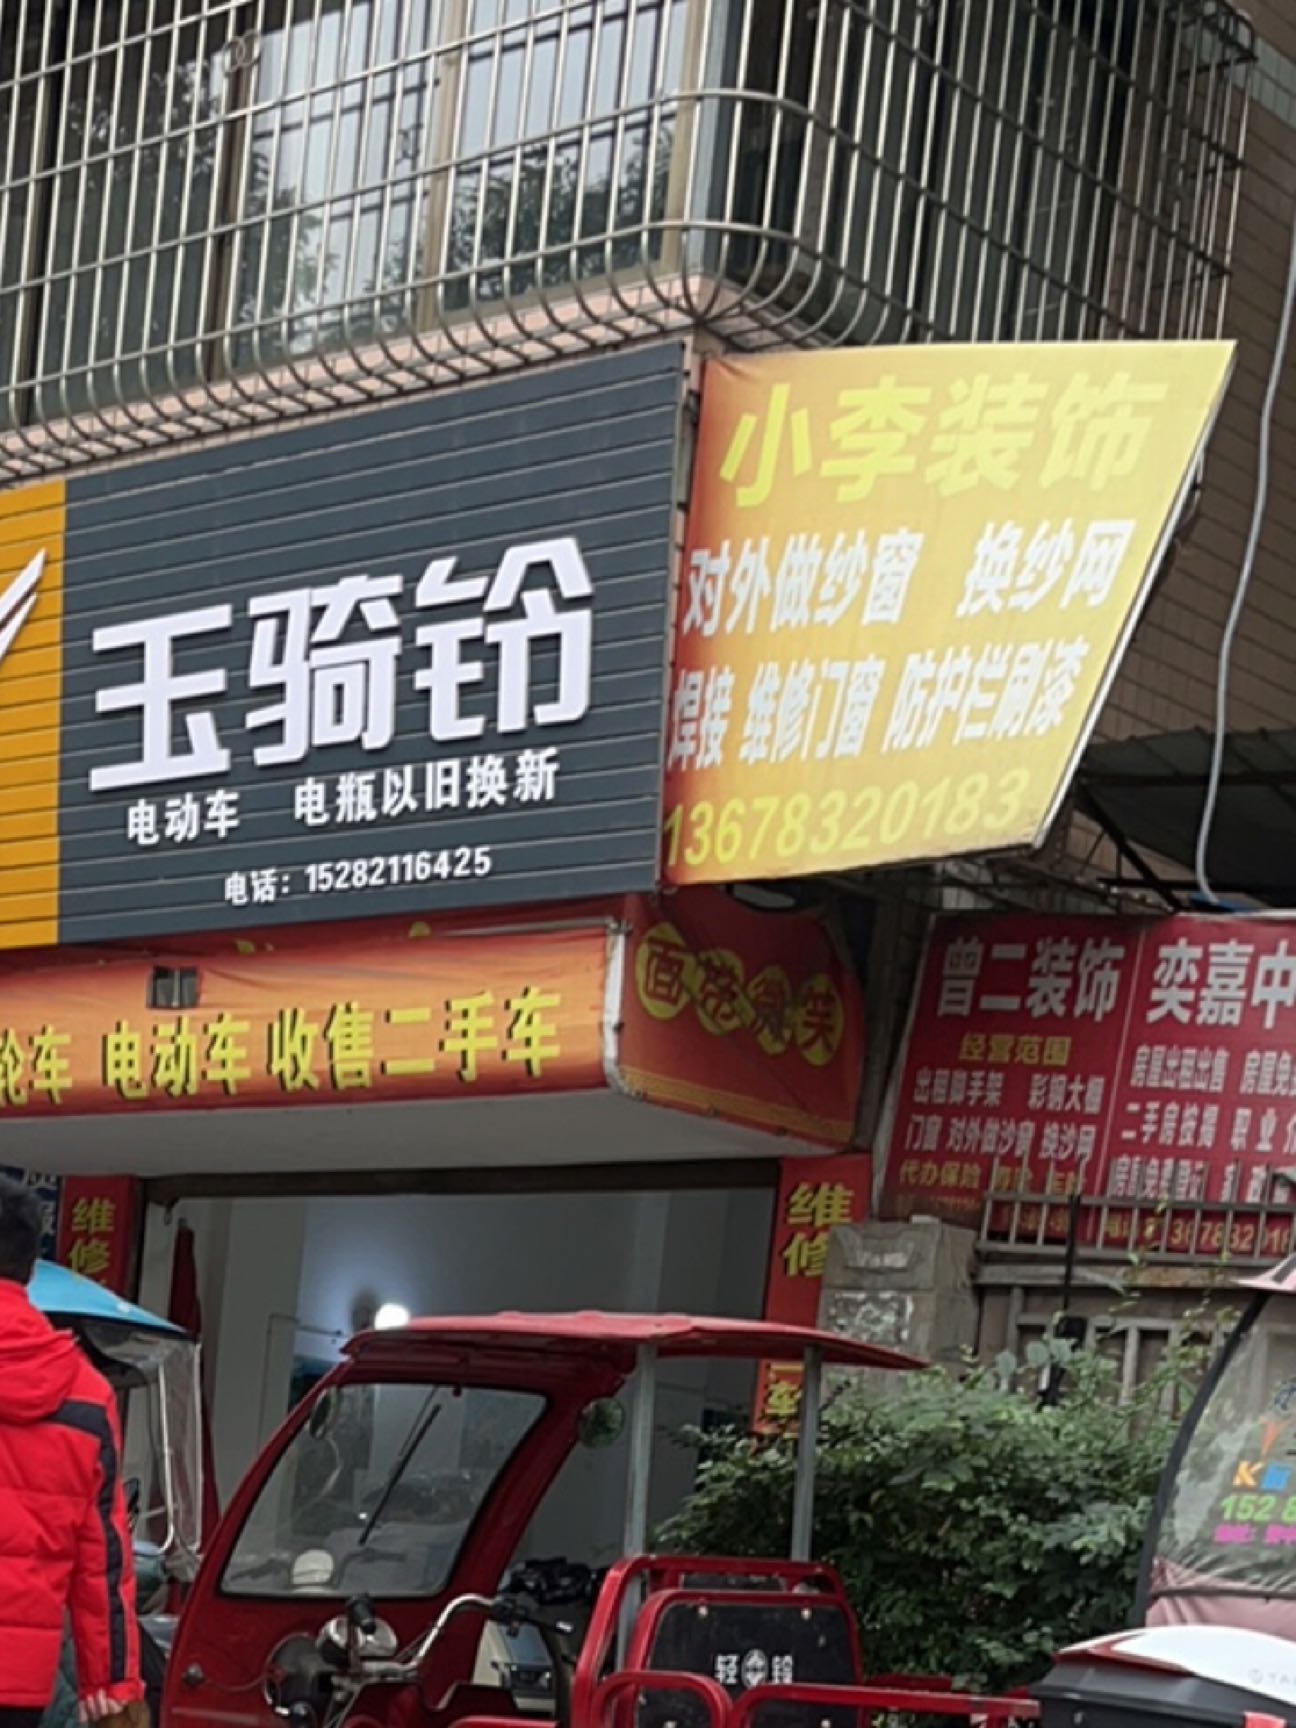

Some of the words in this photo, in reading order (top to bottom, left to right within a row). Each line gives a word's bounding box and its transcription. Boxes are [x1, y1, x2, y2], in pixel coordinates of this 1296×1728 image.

[719, 370, 1166, 508] 小李装饰
[683, 526, 924, 636] 对外做纱窗
[956, 516, 1136, 618] 换纱网
[88, 537, 593, 791] 玉骑铃
[666, 666, 734, 770] 焊接
[737, 655, 885, 765] 维修门窗
[880, 634, 1090, 756] 防护栏刷漆
[125, 788, 240, 846] 电动车
[293, 747, 560, 828] 电瓶以旧换新
[664, 766, 1031, 868] 13678320183
[936, 934, 1125, 1022] 曾二装饰
[102, 1012, 251, 1099] 电动车
[959, 1030, 1072, 1067] 经营范围
[1240, 1049, 1296, 1098] 房屋免
[1221, 1494, 1276, 1522] 152
